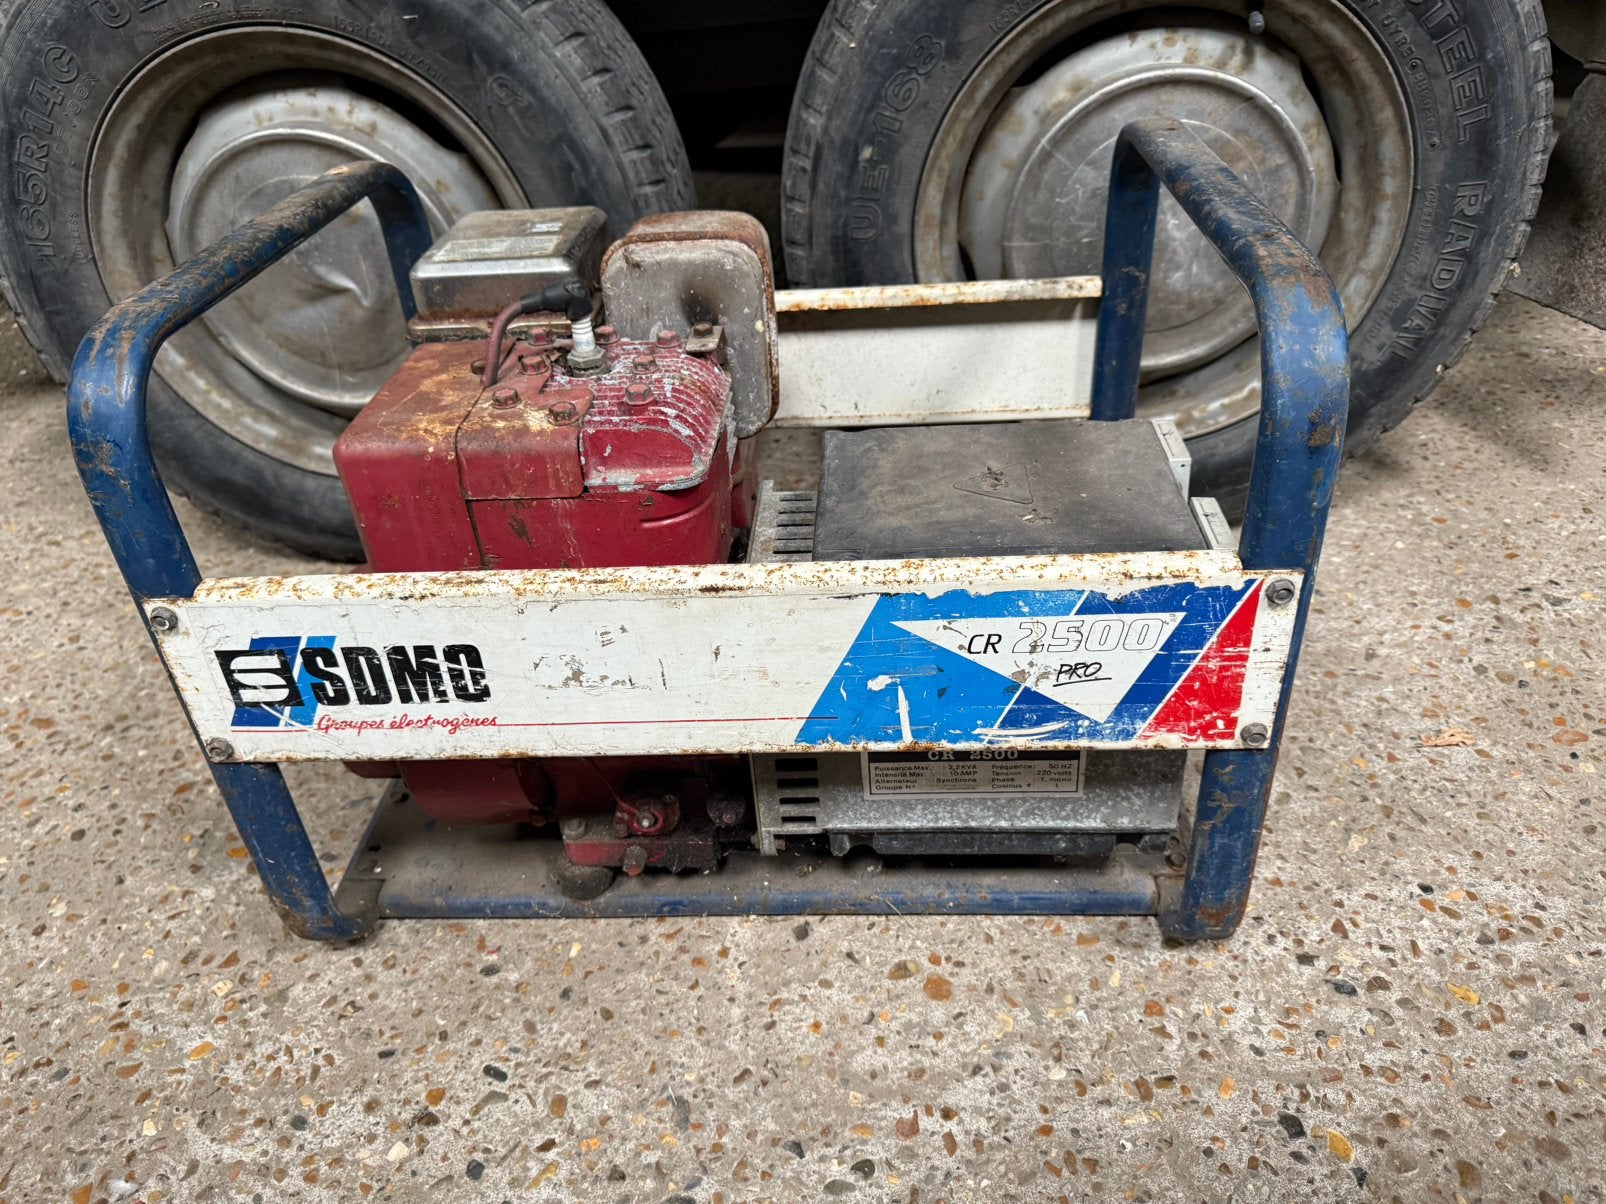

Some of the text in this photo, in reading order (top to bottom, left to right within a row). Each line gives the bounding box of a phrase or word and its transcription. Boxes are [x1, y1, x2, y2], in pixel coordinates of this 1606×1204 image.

[14, 43, 80, 260] 165R14C
[1375, 179, 1489, 366] RADIAL
[967, 617, 1164, 654] CR 2500
[300, 643, 492, 706] SDMO
[1056, 661, 1102, 683] PRO
[317, 709, 498, 736] Groupes électrogènes
